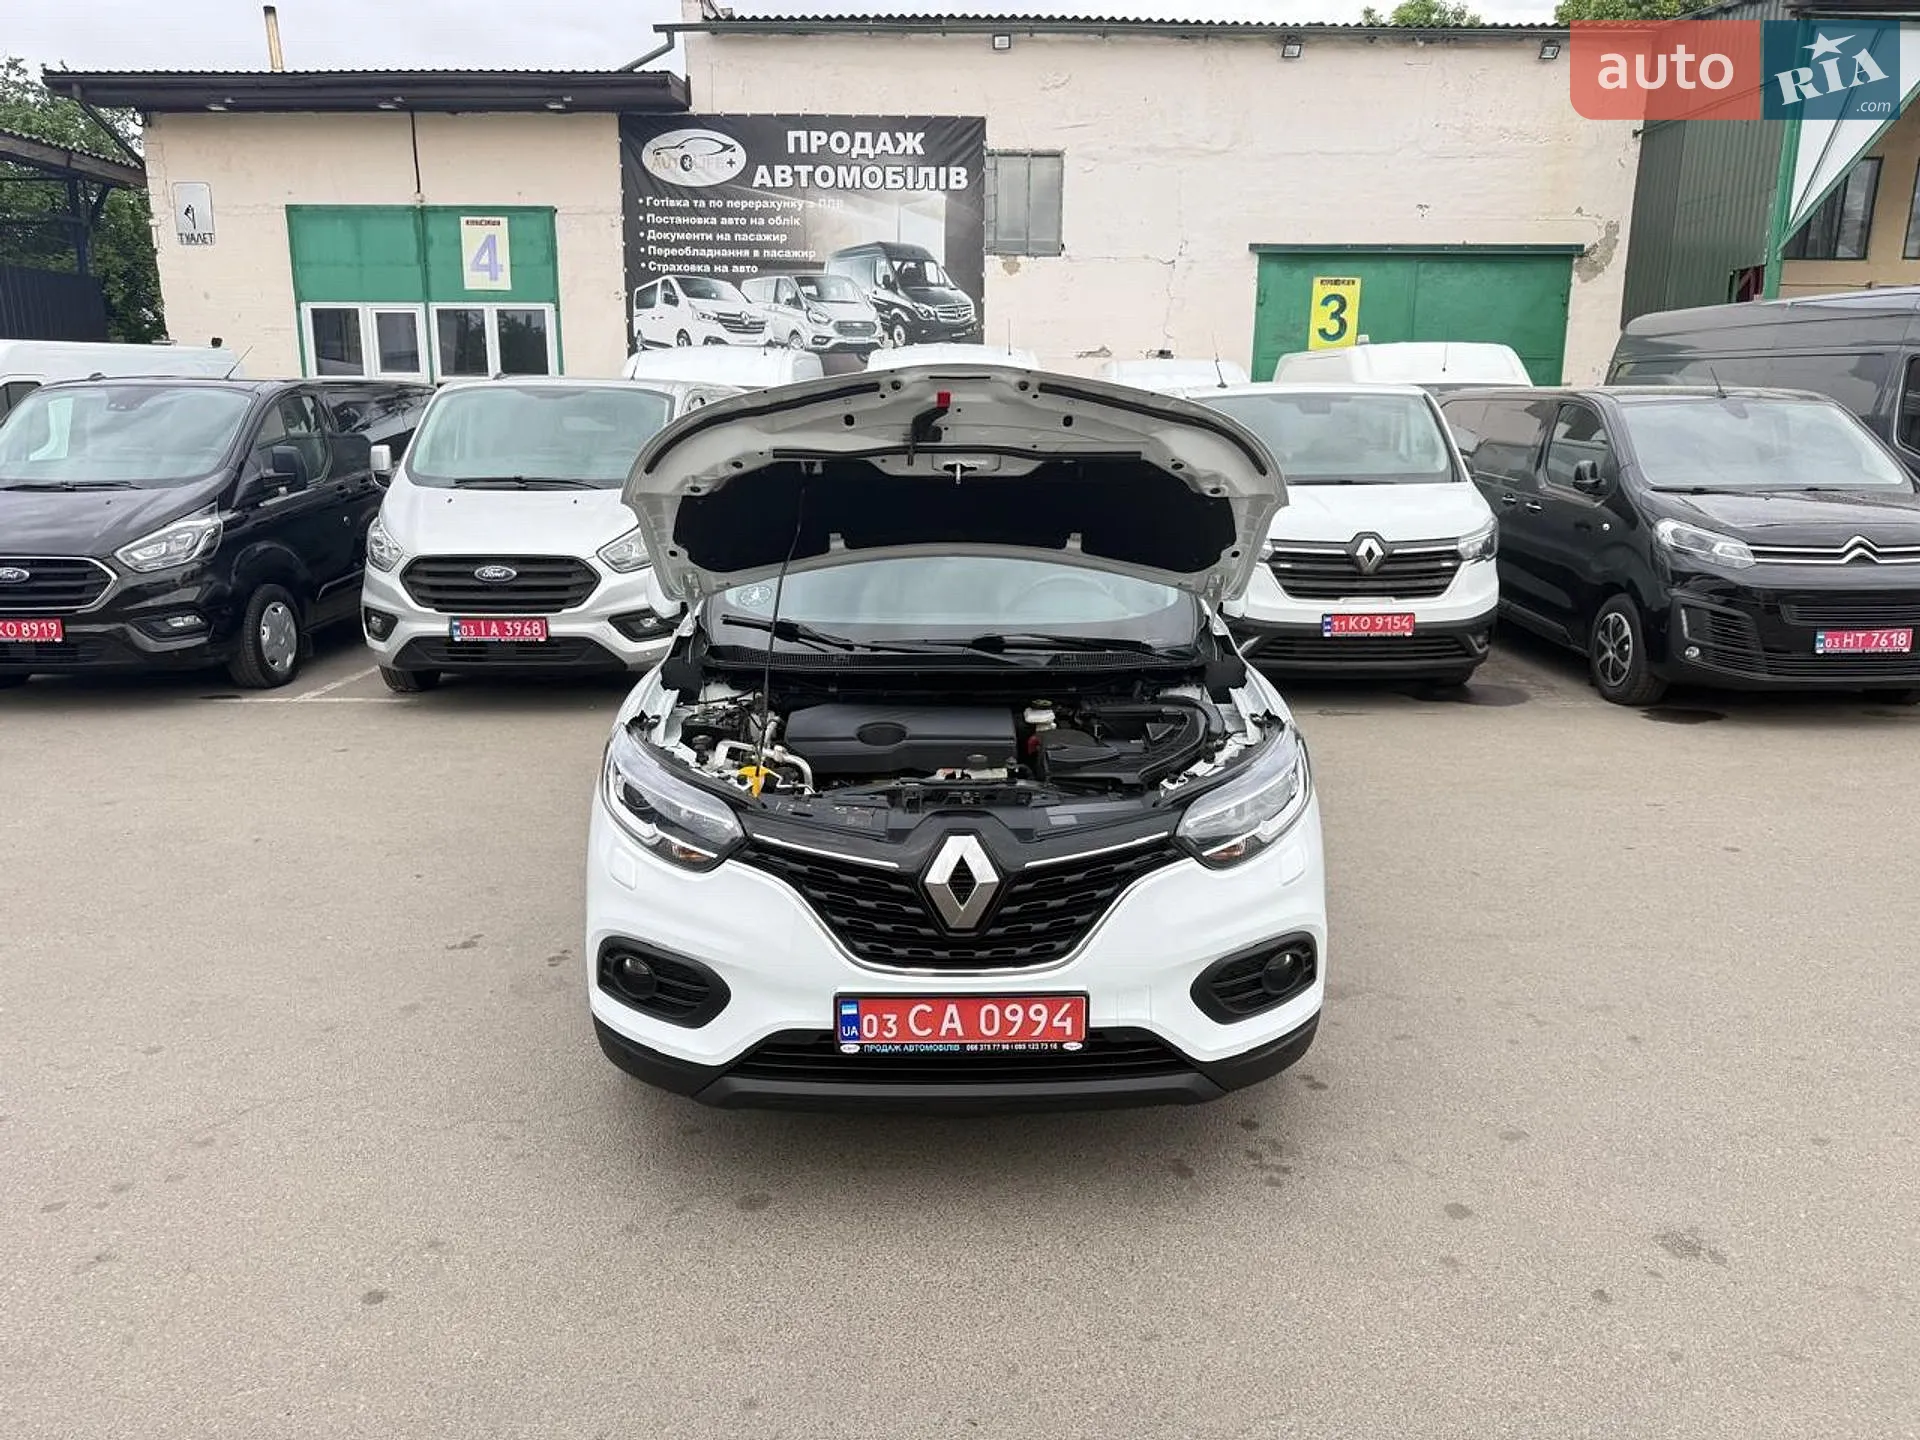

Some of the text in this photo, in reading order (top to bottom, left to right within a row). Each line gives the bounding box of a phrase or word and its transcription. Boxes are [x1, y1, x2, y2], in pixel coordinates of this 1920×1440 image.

[787, 130, 926, 159] ПРОДАЖ
[752, 165, 969, 190] АВТОМОБІЛІВ
[646, 197, 690, 208] Готівка
[693, 200, 706, 208] та
[709, 200, 723, 208] по
[727, 200, 803, 211] перерахунку
[646, 214, 801, 226] Постановка авто на облік
[177, 233, 214, 246] ТУАЛЕТ
[647, 230, 788, 243] Документи на пасажир
[471, 234, 504, 281] 4
[648, 246, 816, 261] Переобладнання в пасажир
[648, 261, 759, 273] Страховка на авто
[1318, 294, 1347, 341] 3
[21, 622, 57, 637] 8919
[461, 625, 475, 636] 03
[504, 621, 541, 636] 3968
[1349, 616, 1371, 630] KO
[1375, 616, 1410, 630] 9154
[1825, 632, 1907, 648] 03 HT 7618
[862, 1002, 1073, 1038] 03 CA 0994
[842, 1027, 859, 1037] UA
[864, 1044, 901, 1053] ПРОДАЖ
